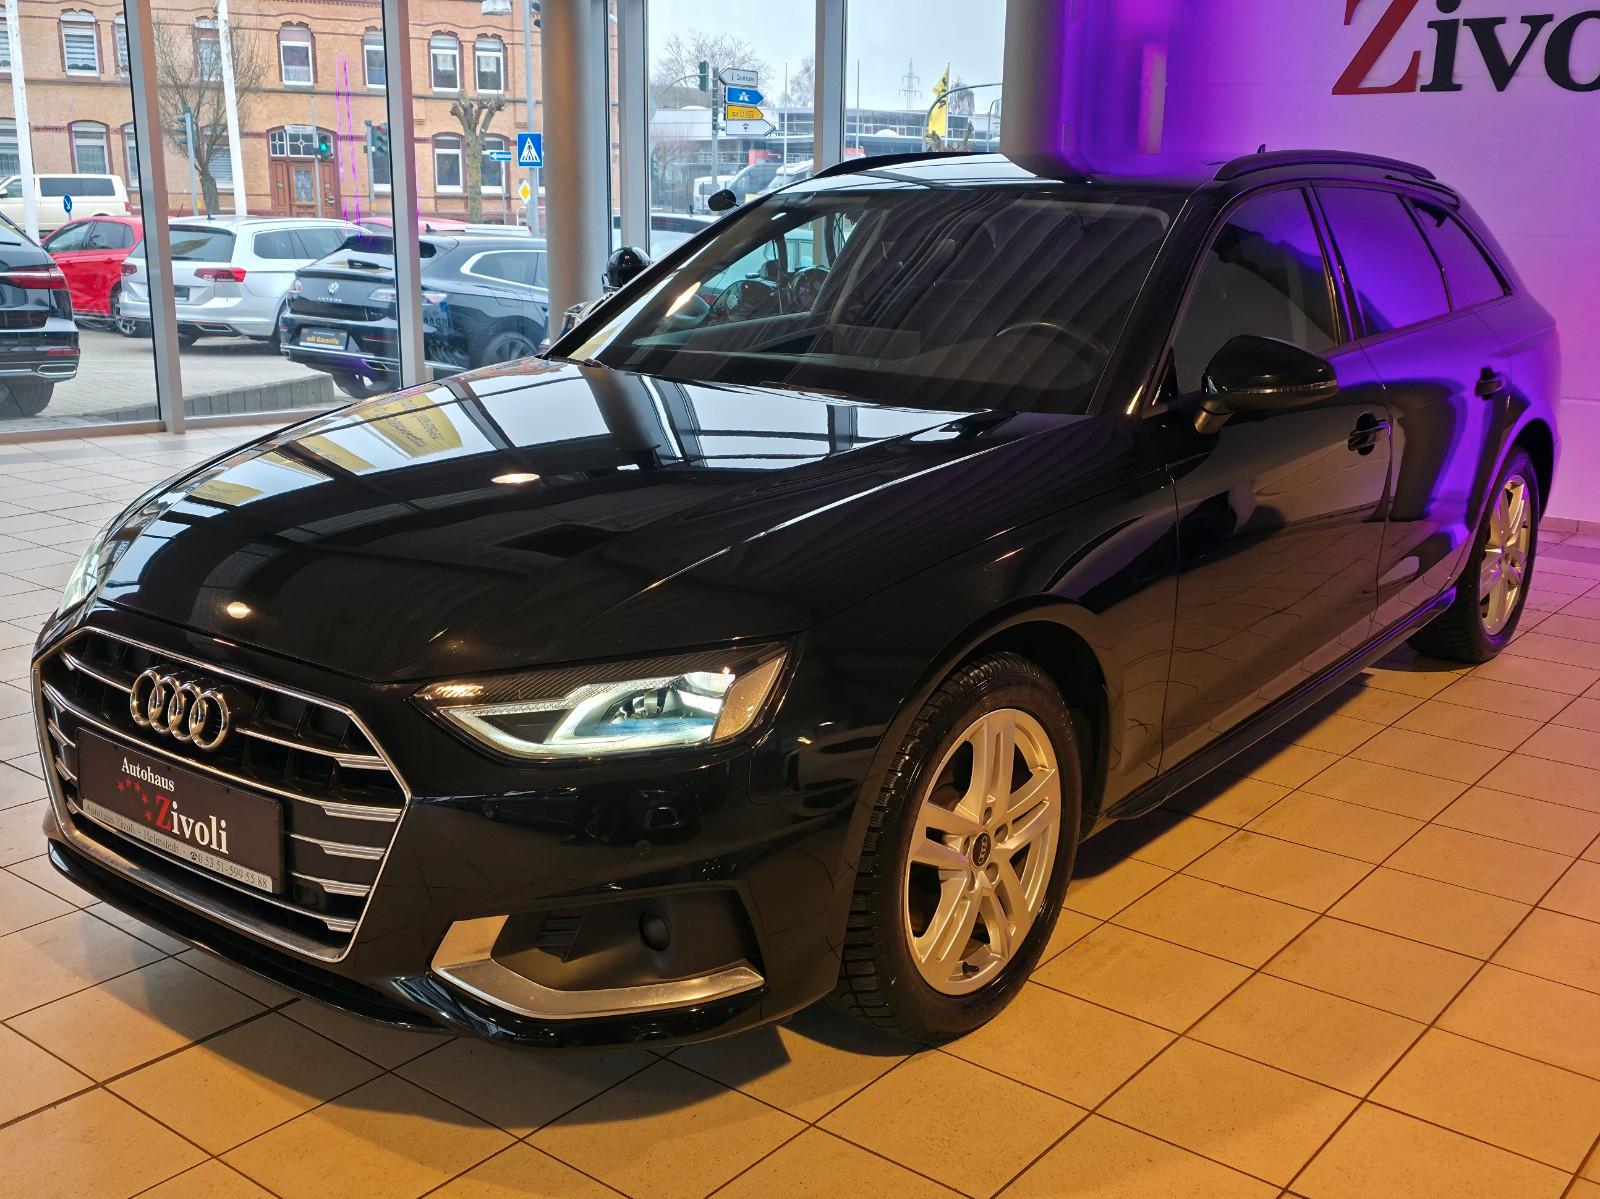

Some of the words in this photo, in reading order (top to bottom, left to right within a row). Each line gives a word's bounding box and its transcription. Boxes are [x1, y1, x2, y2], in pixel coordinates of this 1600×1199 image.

[122, 757, 175, 792] Autohaus
[86, 804, 114, 824] Autohaus
[115, 817, 135, 834] Zivoli
[143, 830, 179, 854] Helmstedt
[155, 794, 229, 855] Zivoli
